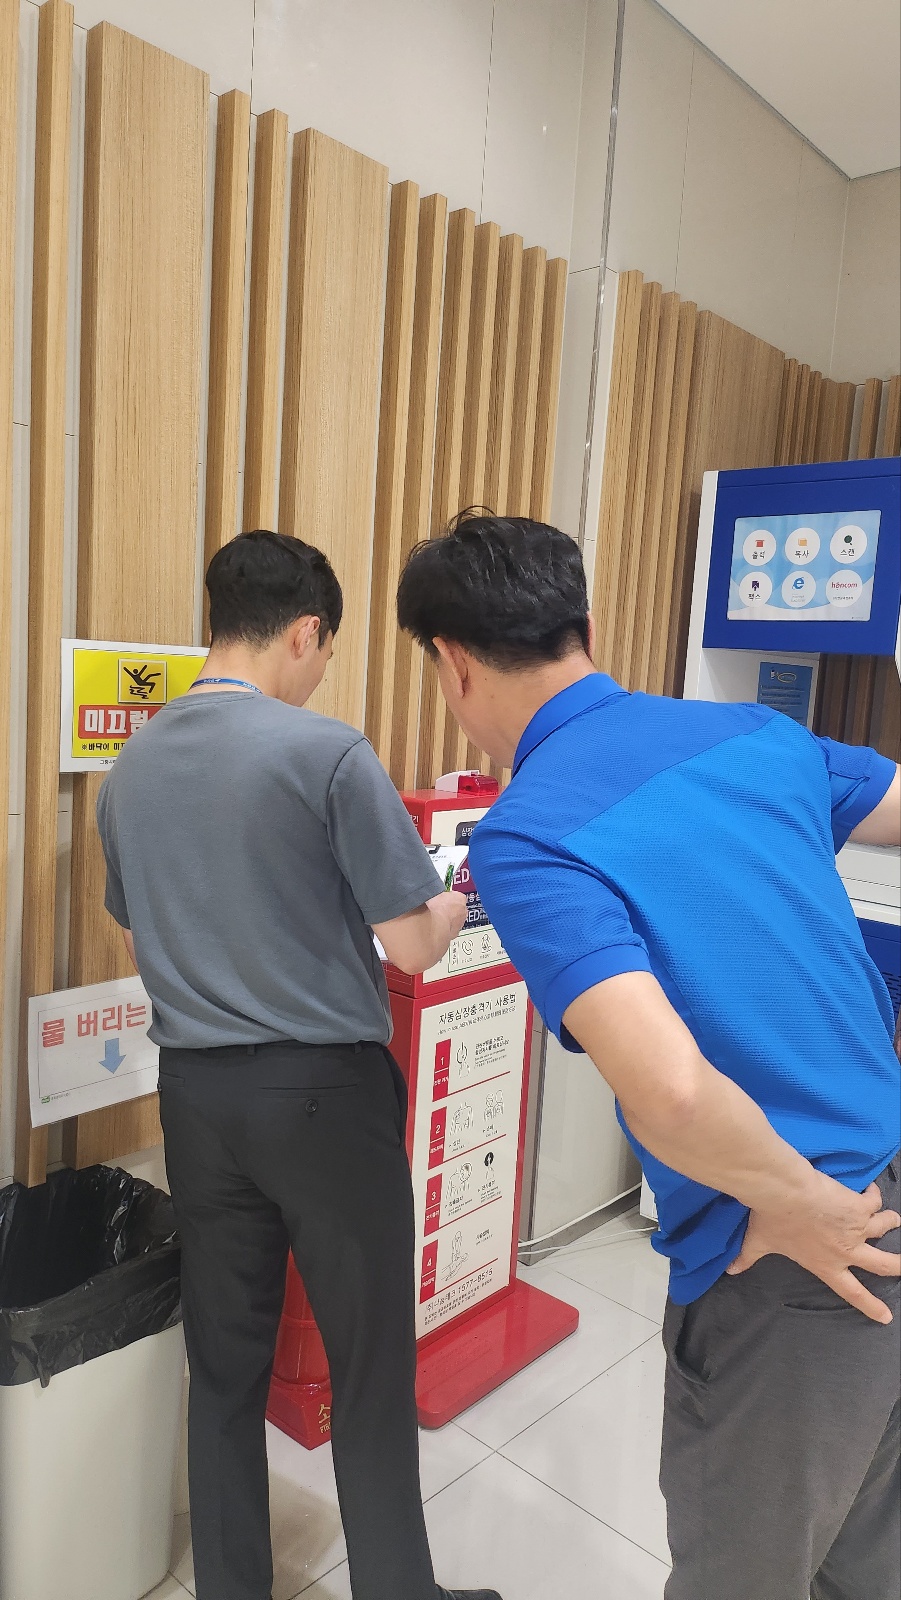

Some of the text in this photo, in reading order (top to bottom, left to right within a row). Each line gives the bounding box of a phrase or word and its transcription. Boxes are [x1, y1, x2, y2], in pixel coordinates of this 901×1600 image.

[794, 549, 809, 559] 복사
[840, 548, 855, 557] 스캔
[748, 592, 762, 601] 팩스
[84, 709, 149, 734] 미끄럼
[438, 1000, 492, 1025] 자동심장충격기
[494, 992, 516, 1007] 사용법
[42, 1003, 146, 1048] 물 버리는
[440, 1056, 445, 1065] 1
[435, 1124, 441, 1134] 2
[431, 1191, 437, 1200] 3
[427, 1258, 432, 1266] 4
